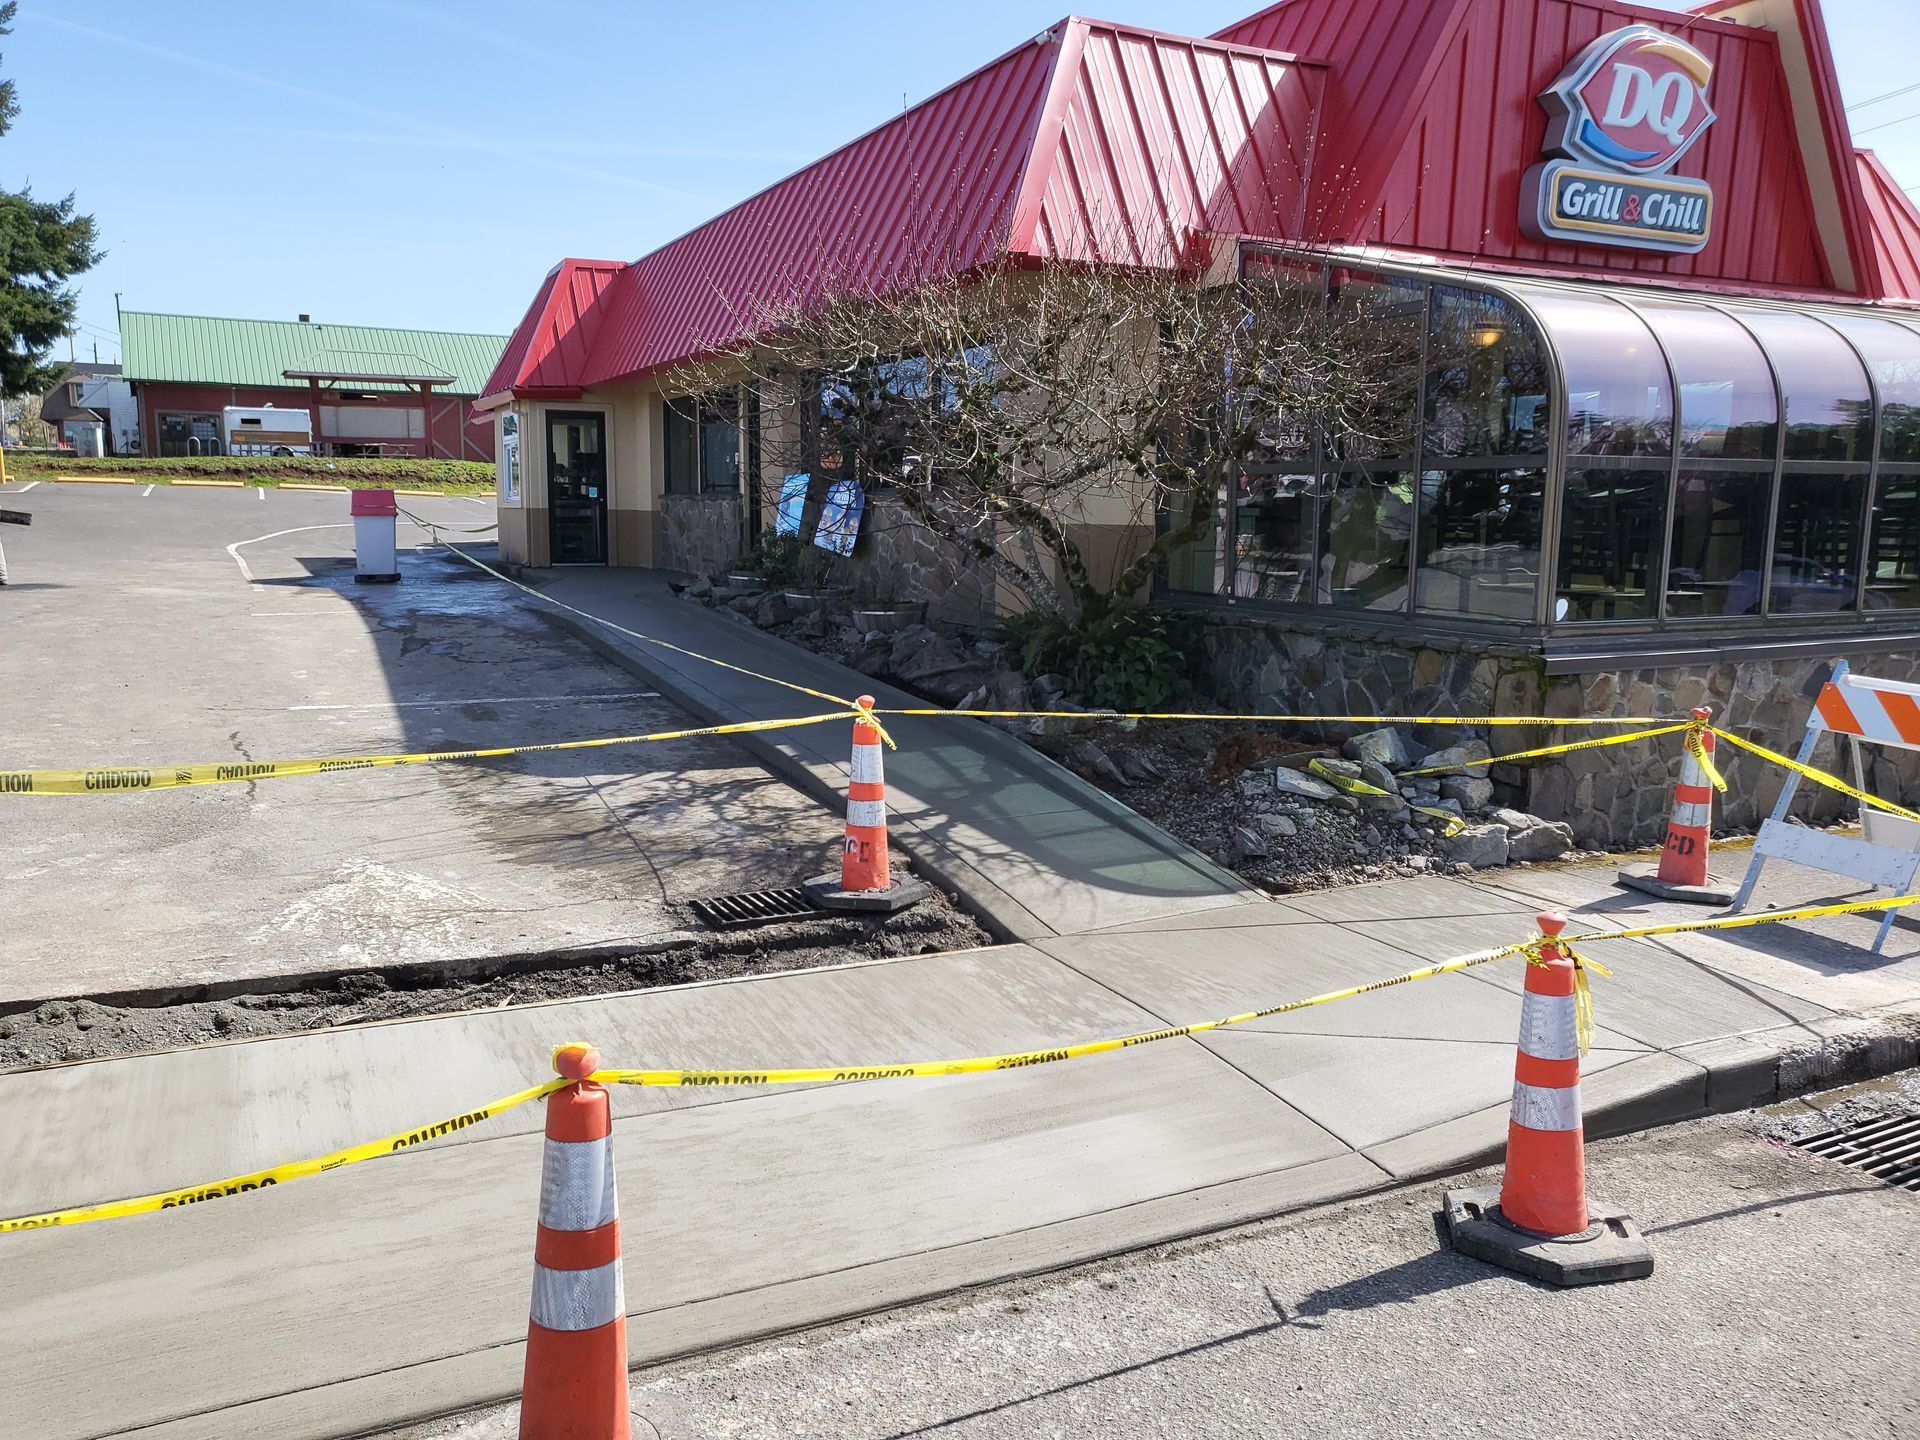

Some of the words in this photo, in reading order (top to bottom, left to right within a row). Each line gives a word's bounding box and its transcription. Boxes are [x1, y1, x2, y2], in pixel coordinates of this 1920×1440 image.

[1602, 62, 1694, 146] DQ
[1562, 182, 1625, 221] Grill
[1622, 195, 1641, 222] &
[1642, 193, 1704, 231] Chill
